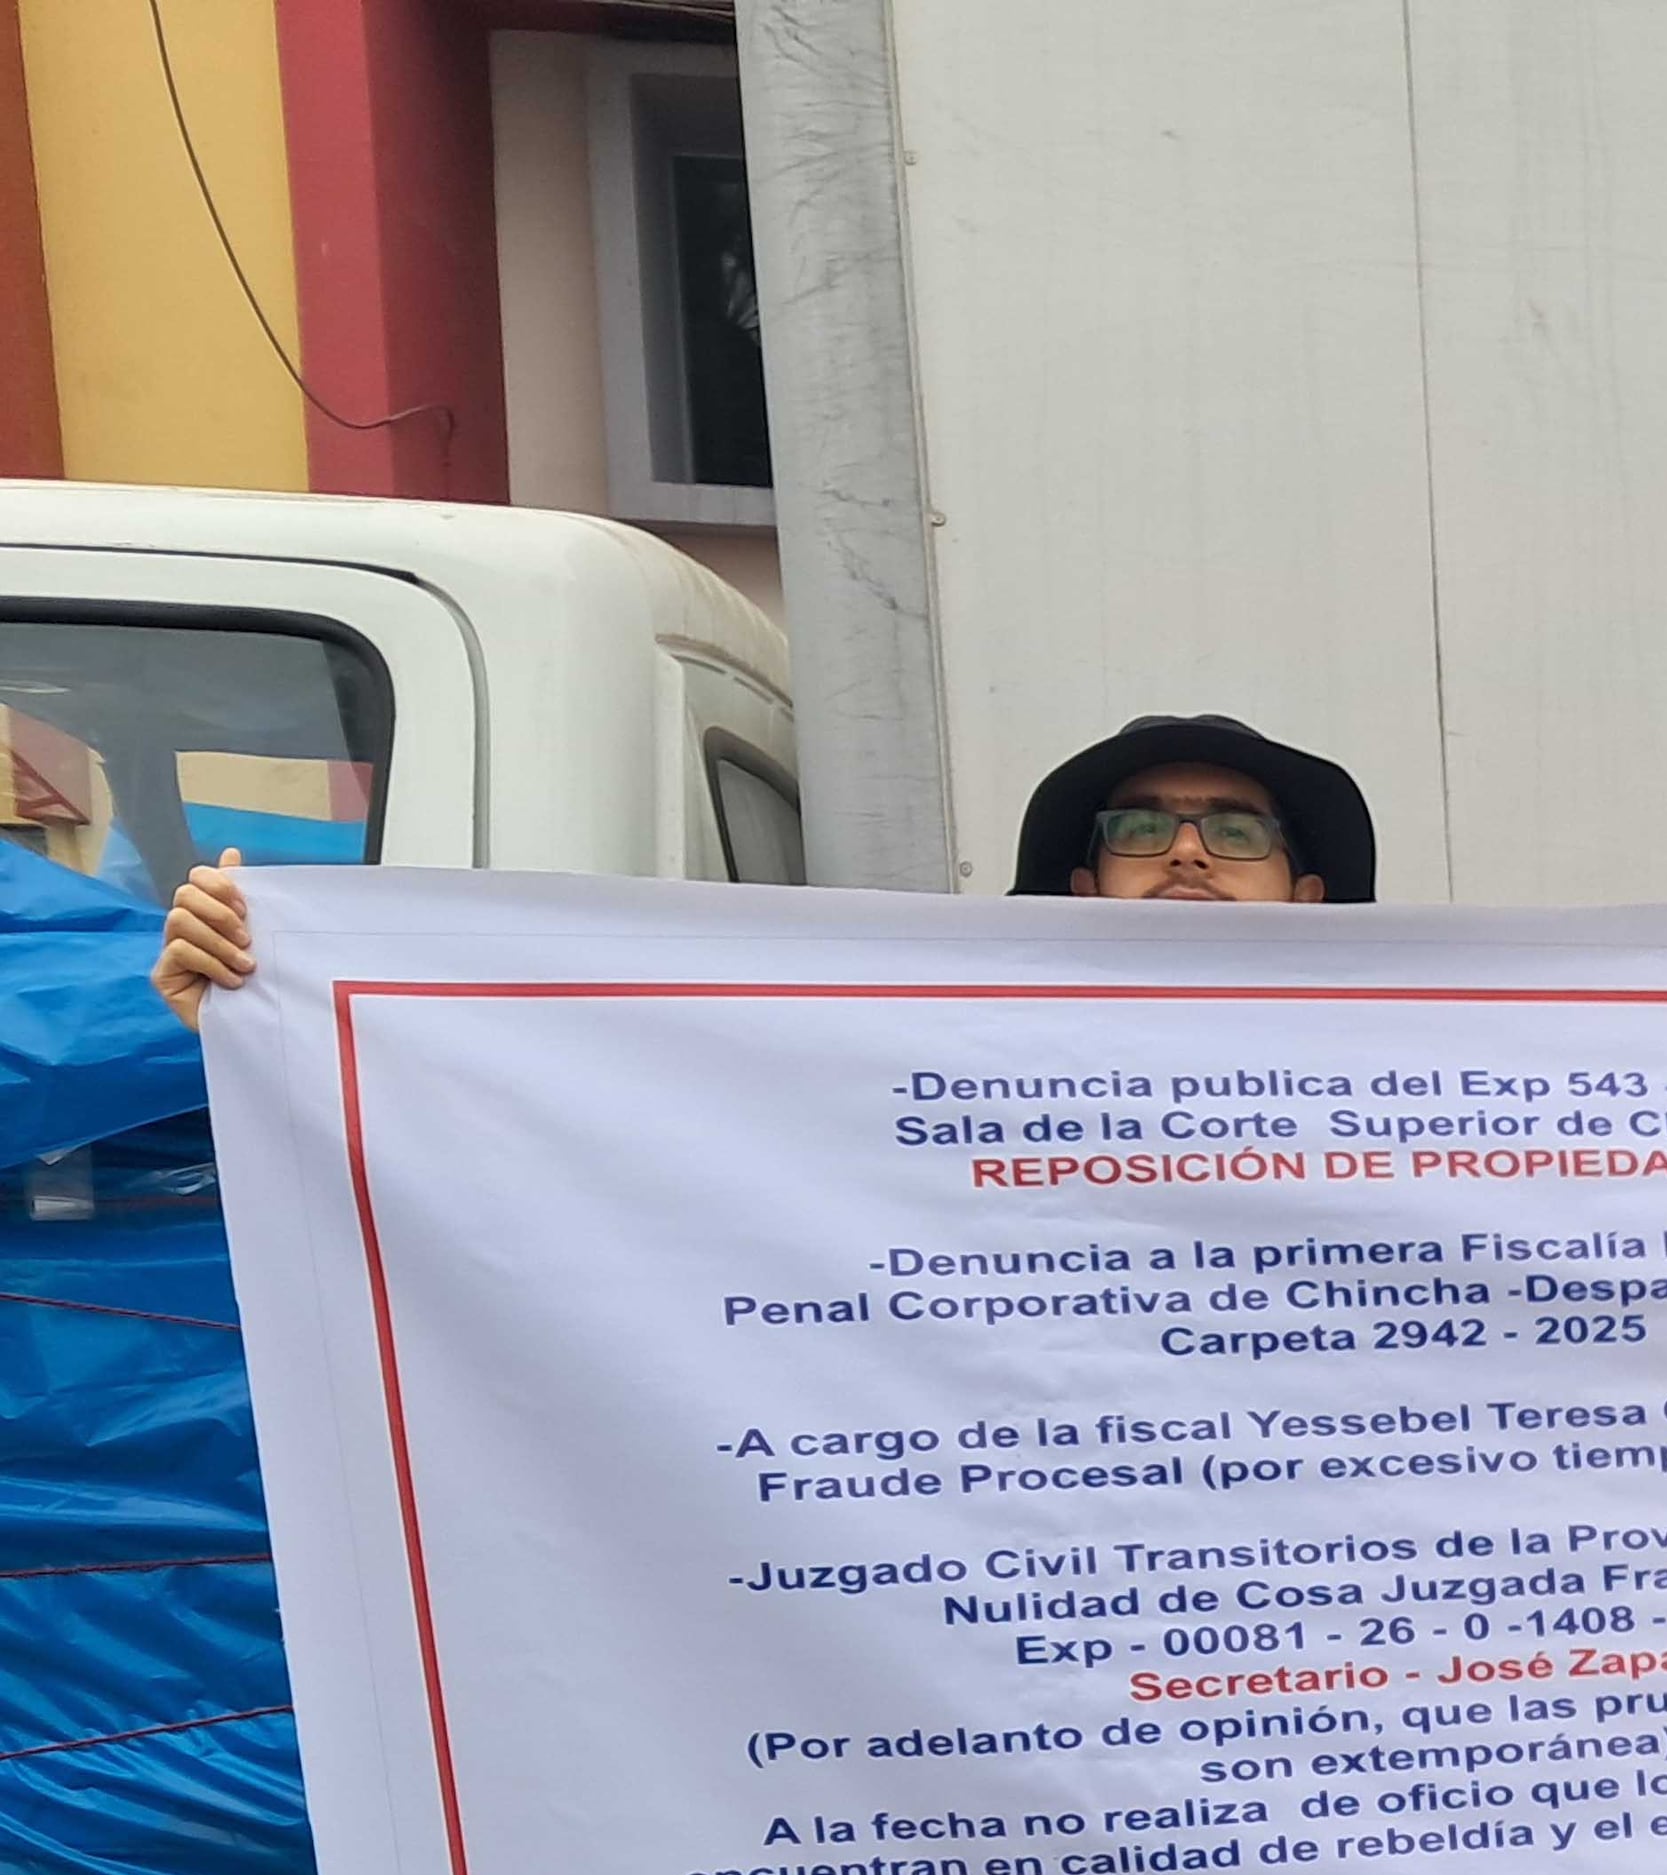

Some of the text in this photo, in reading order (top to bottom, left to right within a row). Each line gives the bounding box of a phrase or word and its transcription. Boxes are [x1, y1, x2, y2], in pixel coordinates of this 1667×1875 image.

[892, 1069, 1153, 1101] -Denuncia
[1170, 1069, 1353, 1105] publica
[1370, 1069, 1442, 1097] del
[1459, 1070, 1551, 1103] Exp
[1567, 1071, 1649, 1098] 543
[895, 1114, 1005, 1147] Sala
[1022, 1113, 1085, 1143] de
[1100, 1111, 1144, 1141] la
[1160, 1110, 1298, 1140] Corte
[1329, 1109, 1541, 1144] Superior
[1556, 1109, 1613, 1137] de
[971, 1145, 1306, 1188] REPOSICIÓN
[1323, 1150, 1395, 1180] DE
[869, 1243, 1132, 1277] -Denuncia
[1148, 1247, 1177, 1271] a
[1193, 1240, 1236, 1270] la
[1253, 1236, 1444, 1275] primera
[1461, 1230, 1647, 1263] Fiscalía
[723, 1292, 870, 1326] Penal
[888, 1285, 1193, 1326] Corporativa
[1209, 1282, 1269, 1312] de
[1286, 1276, 1491, 1310] Chincha
[1160, 1324, 1357, 1361] Carpeta
[1372, 1318, 1487, 1350] 2942
[1534, 1313, 1647, 1345] 2025
[716, 1428, 776, 1459] -A
[790, 1429, 940, 1461] cargo
[957, 1420, 1021, 1450] de
[1037, 1417, 1081, 1448] la
[1094, 1411, 1232, 1445] fiscal
[1246, 1403, 1471, 1439] Yessebel
[1485, 1401, 1648, 1431] Teresa
[758, 1467, 943, 1503] Fraude
[960, 1455, 1184, 1494] Procesal
[1201, 1454, 1305, 1491] (por
[1320, 1445, 1538, 1479] excesivo
[943, 1586, 1140, 1626] Nulidad
[1158, 1584, 1220, 1614] de
[1235, 1580, 1364, 1611] Cosa
[1380, 1566, 1586, 1606] Juzgada
[1130, 1661, 1389, 1702] Secretario
[1436, 1650, 1554, 1685] José
[1060, 1838, 1241, 1875] calidad
[1259, 1834, 1319, 1865] de
[1336, 1819, 1535, 1859] rebeldía
[1549, 1821, 1577, 1852] y
[1593, 1811, 1633, 1841] el
